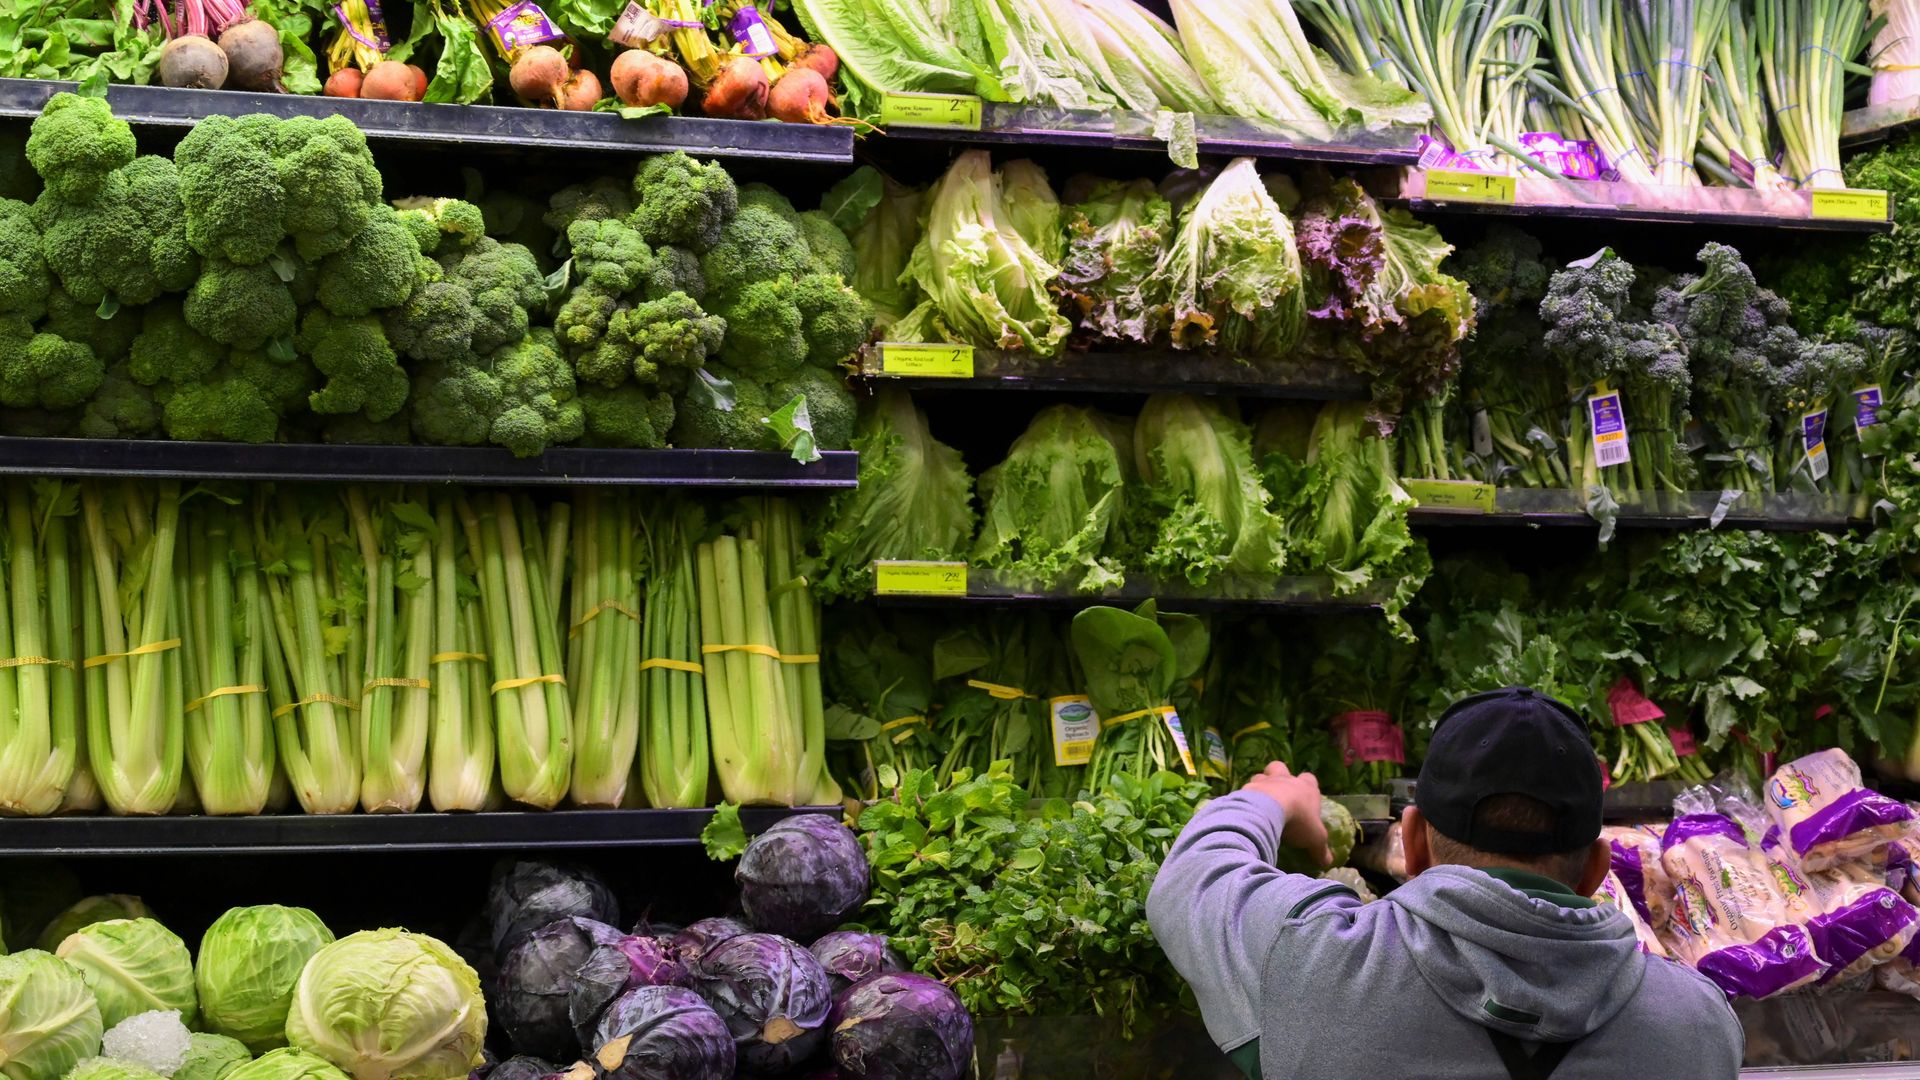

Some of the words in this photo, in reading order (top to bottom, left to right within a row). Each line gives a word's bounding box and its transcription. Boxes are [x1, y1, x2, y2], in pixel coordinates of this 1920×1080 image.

[1065, 725, 1089, 733] Organic
[1701, 848, 1718, 881] Parsnips
[1720, 900, 1738, 931] Organic
